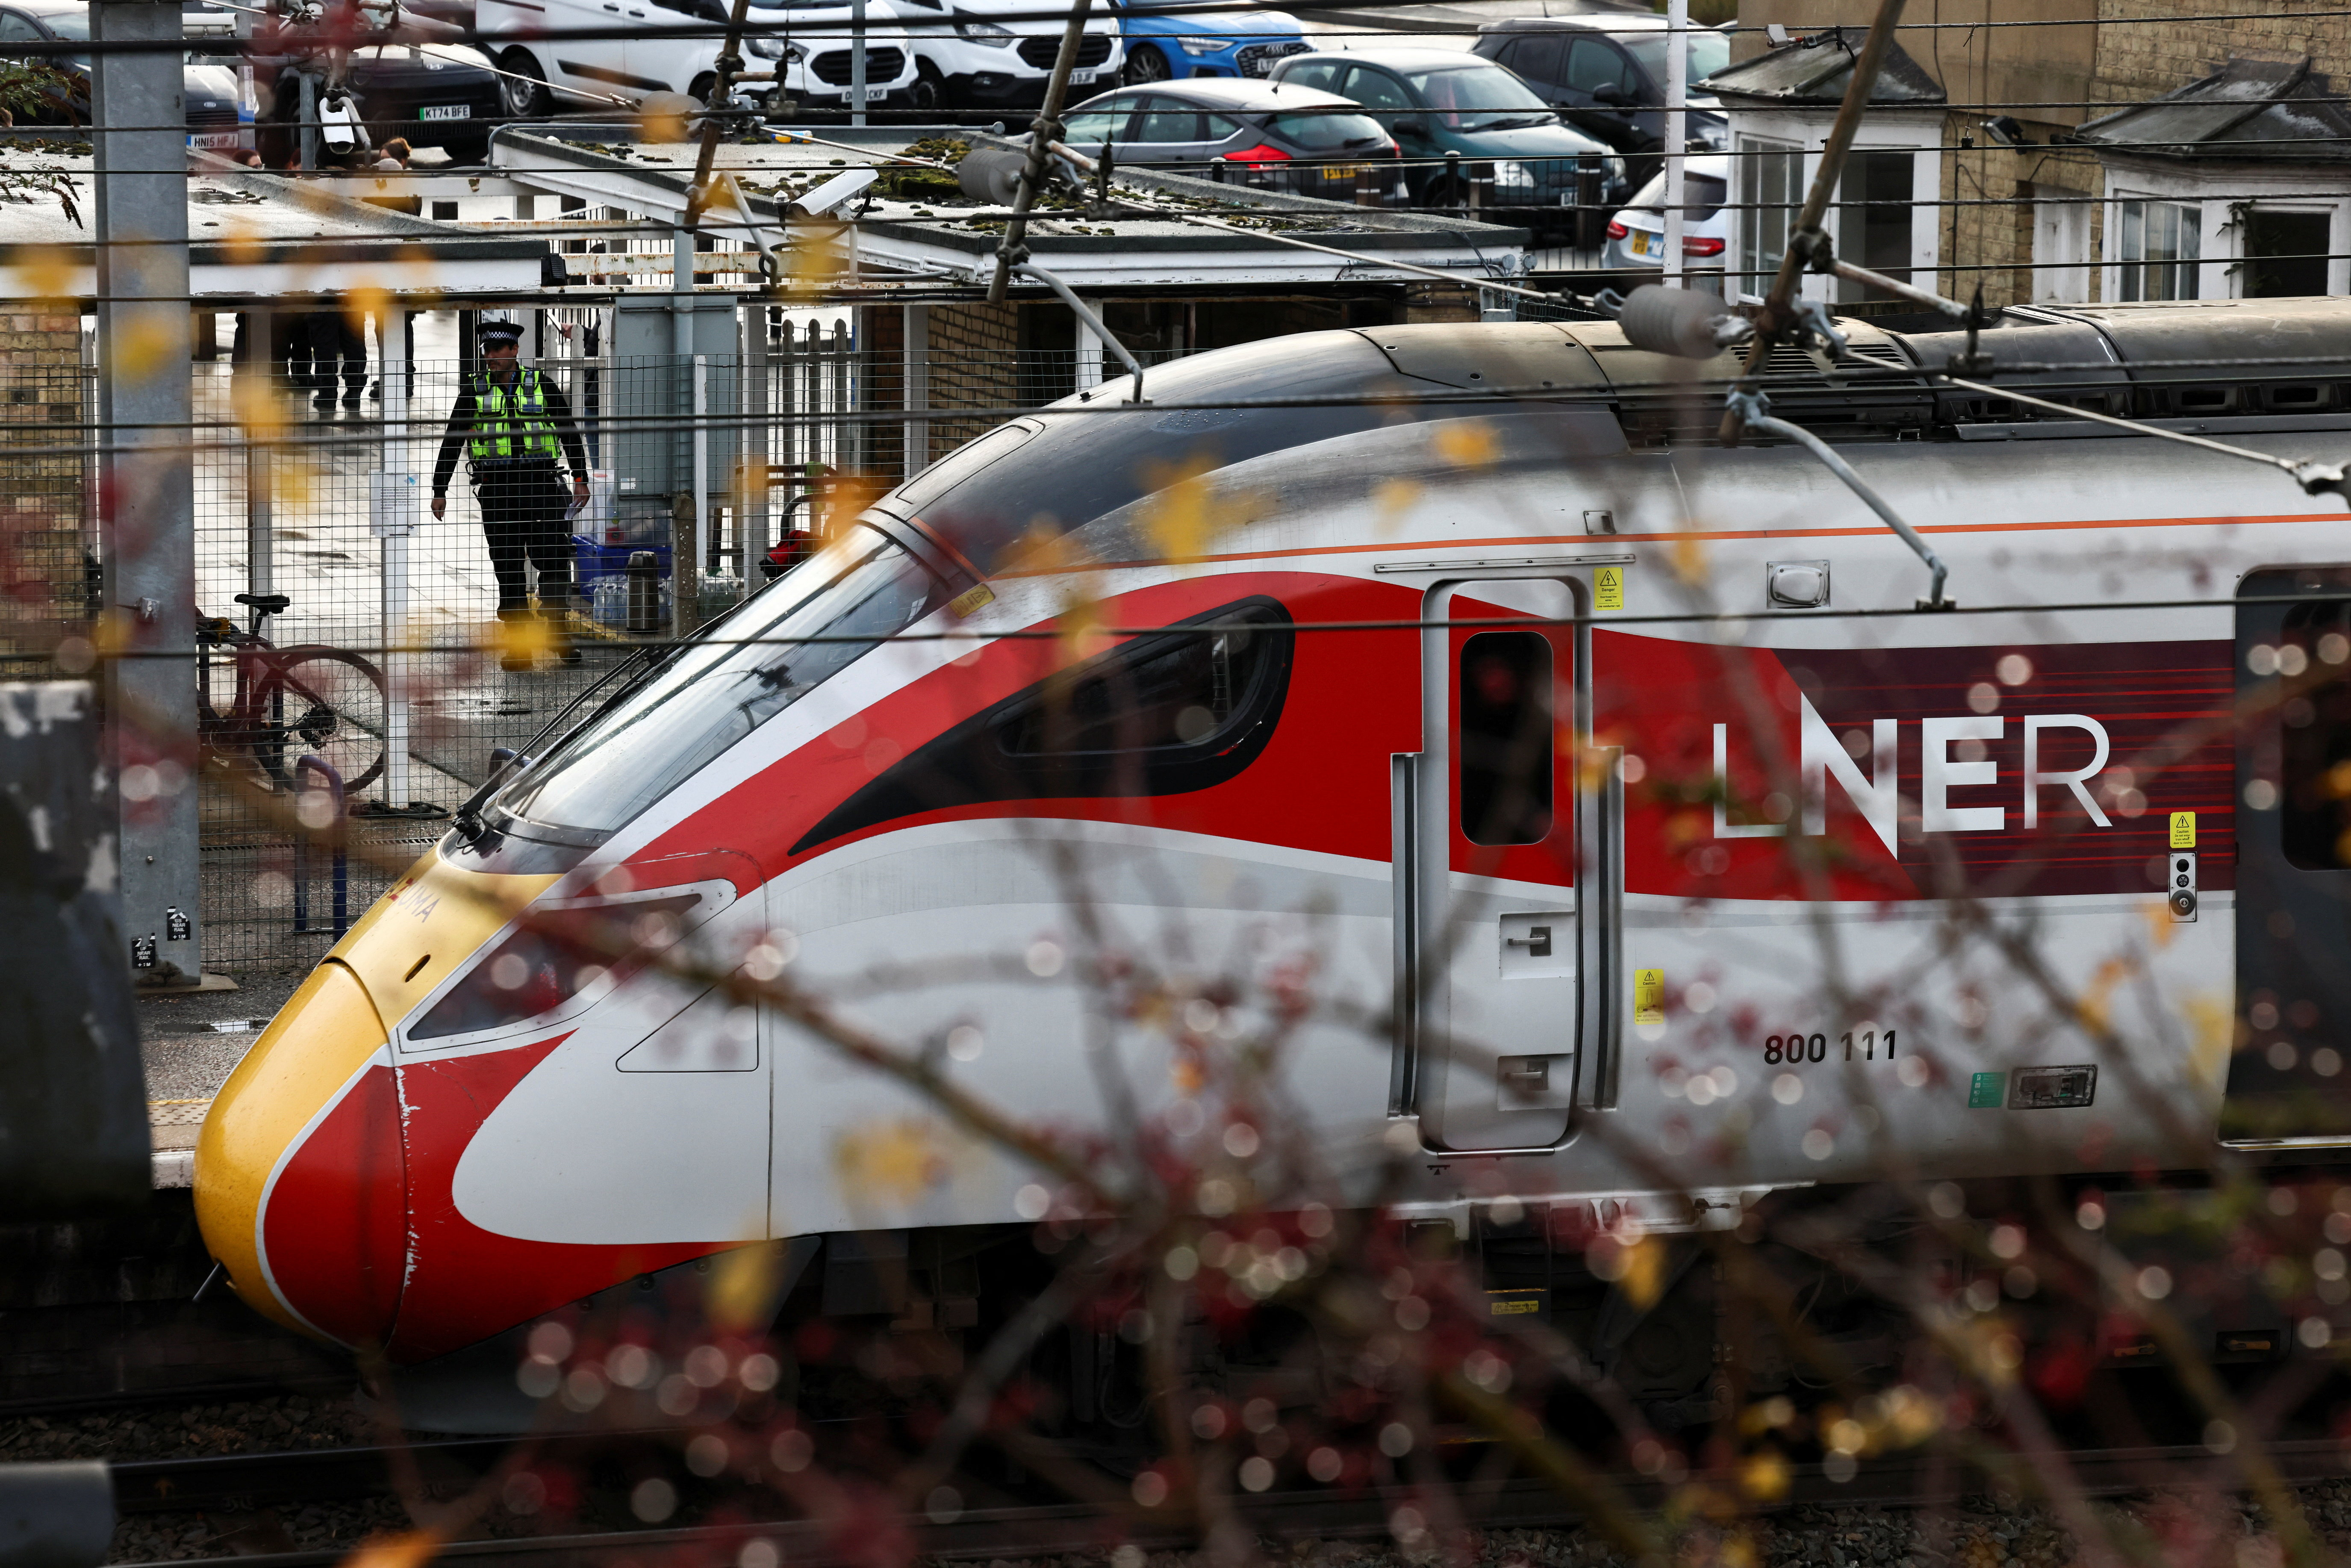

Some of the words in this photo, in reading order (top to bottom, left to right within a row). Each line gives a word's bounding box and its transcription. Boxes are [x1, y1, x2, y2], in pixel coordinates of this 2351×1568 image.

[426, 107, 448, 118] KT74
[452, 106, 468, 117] BFE
[1714, 691, 2113, 861] LNER
[1764, 1033, 1826, 1065] 800
[1841, 1030, 1896, 1061] 111
